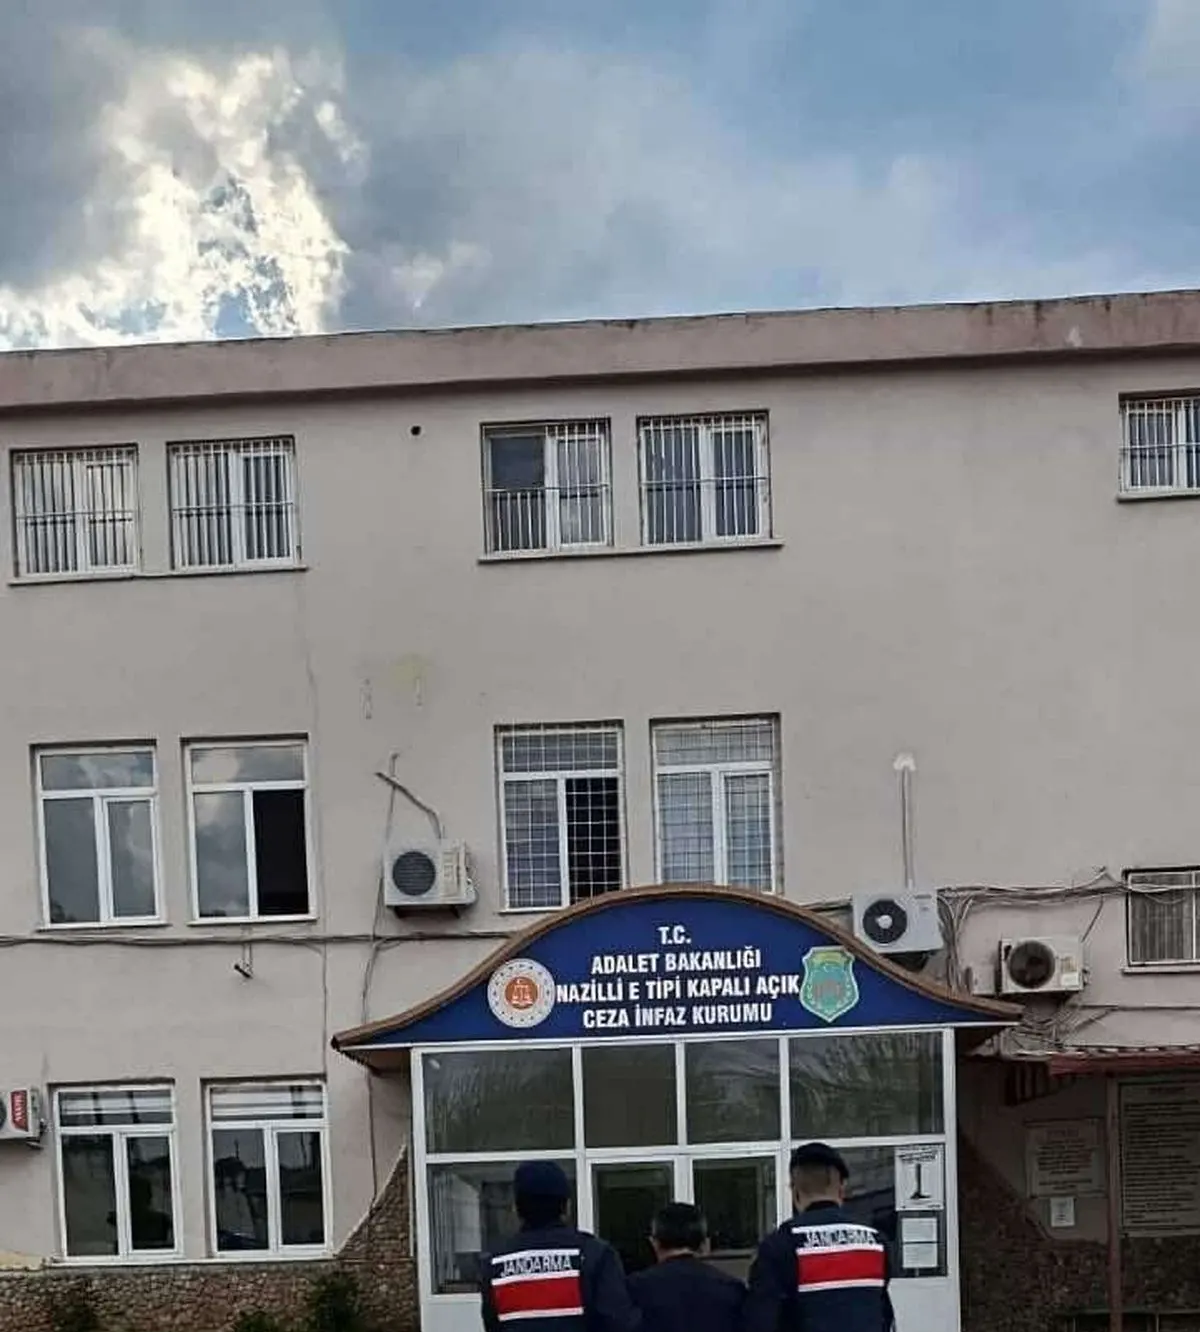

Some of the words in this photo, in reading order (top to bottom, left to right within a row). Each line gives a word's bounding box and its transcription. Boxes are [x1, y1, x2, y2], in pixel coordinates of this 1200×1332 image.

[658, 925, 692, 945] T.C.
[591, 953, 660, 975] ADALET
[665, 945, 761, 972] BAKANLIĞI
[557, 979, 623, 1003] NAZİLLİ
[630, 981, 640, 999] E
[646, 977, 681, 1000] TİPİ
[687, 975, 750, 998] KAPALI
[756, 974, 800, 999] AÇIK
[583, 1008, 629, 1028] CEZA
[635, 1003, 686, 1026] İNFAZ
[692, 1003, 772, 1025] KURUMU
[500, 1254, 573, 1278] JANDARMA
